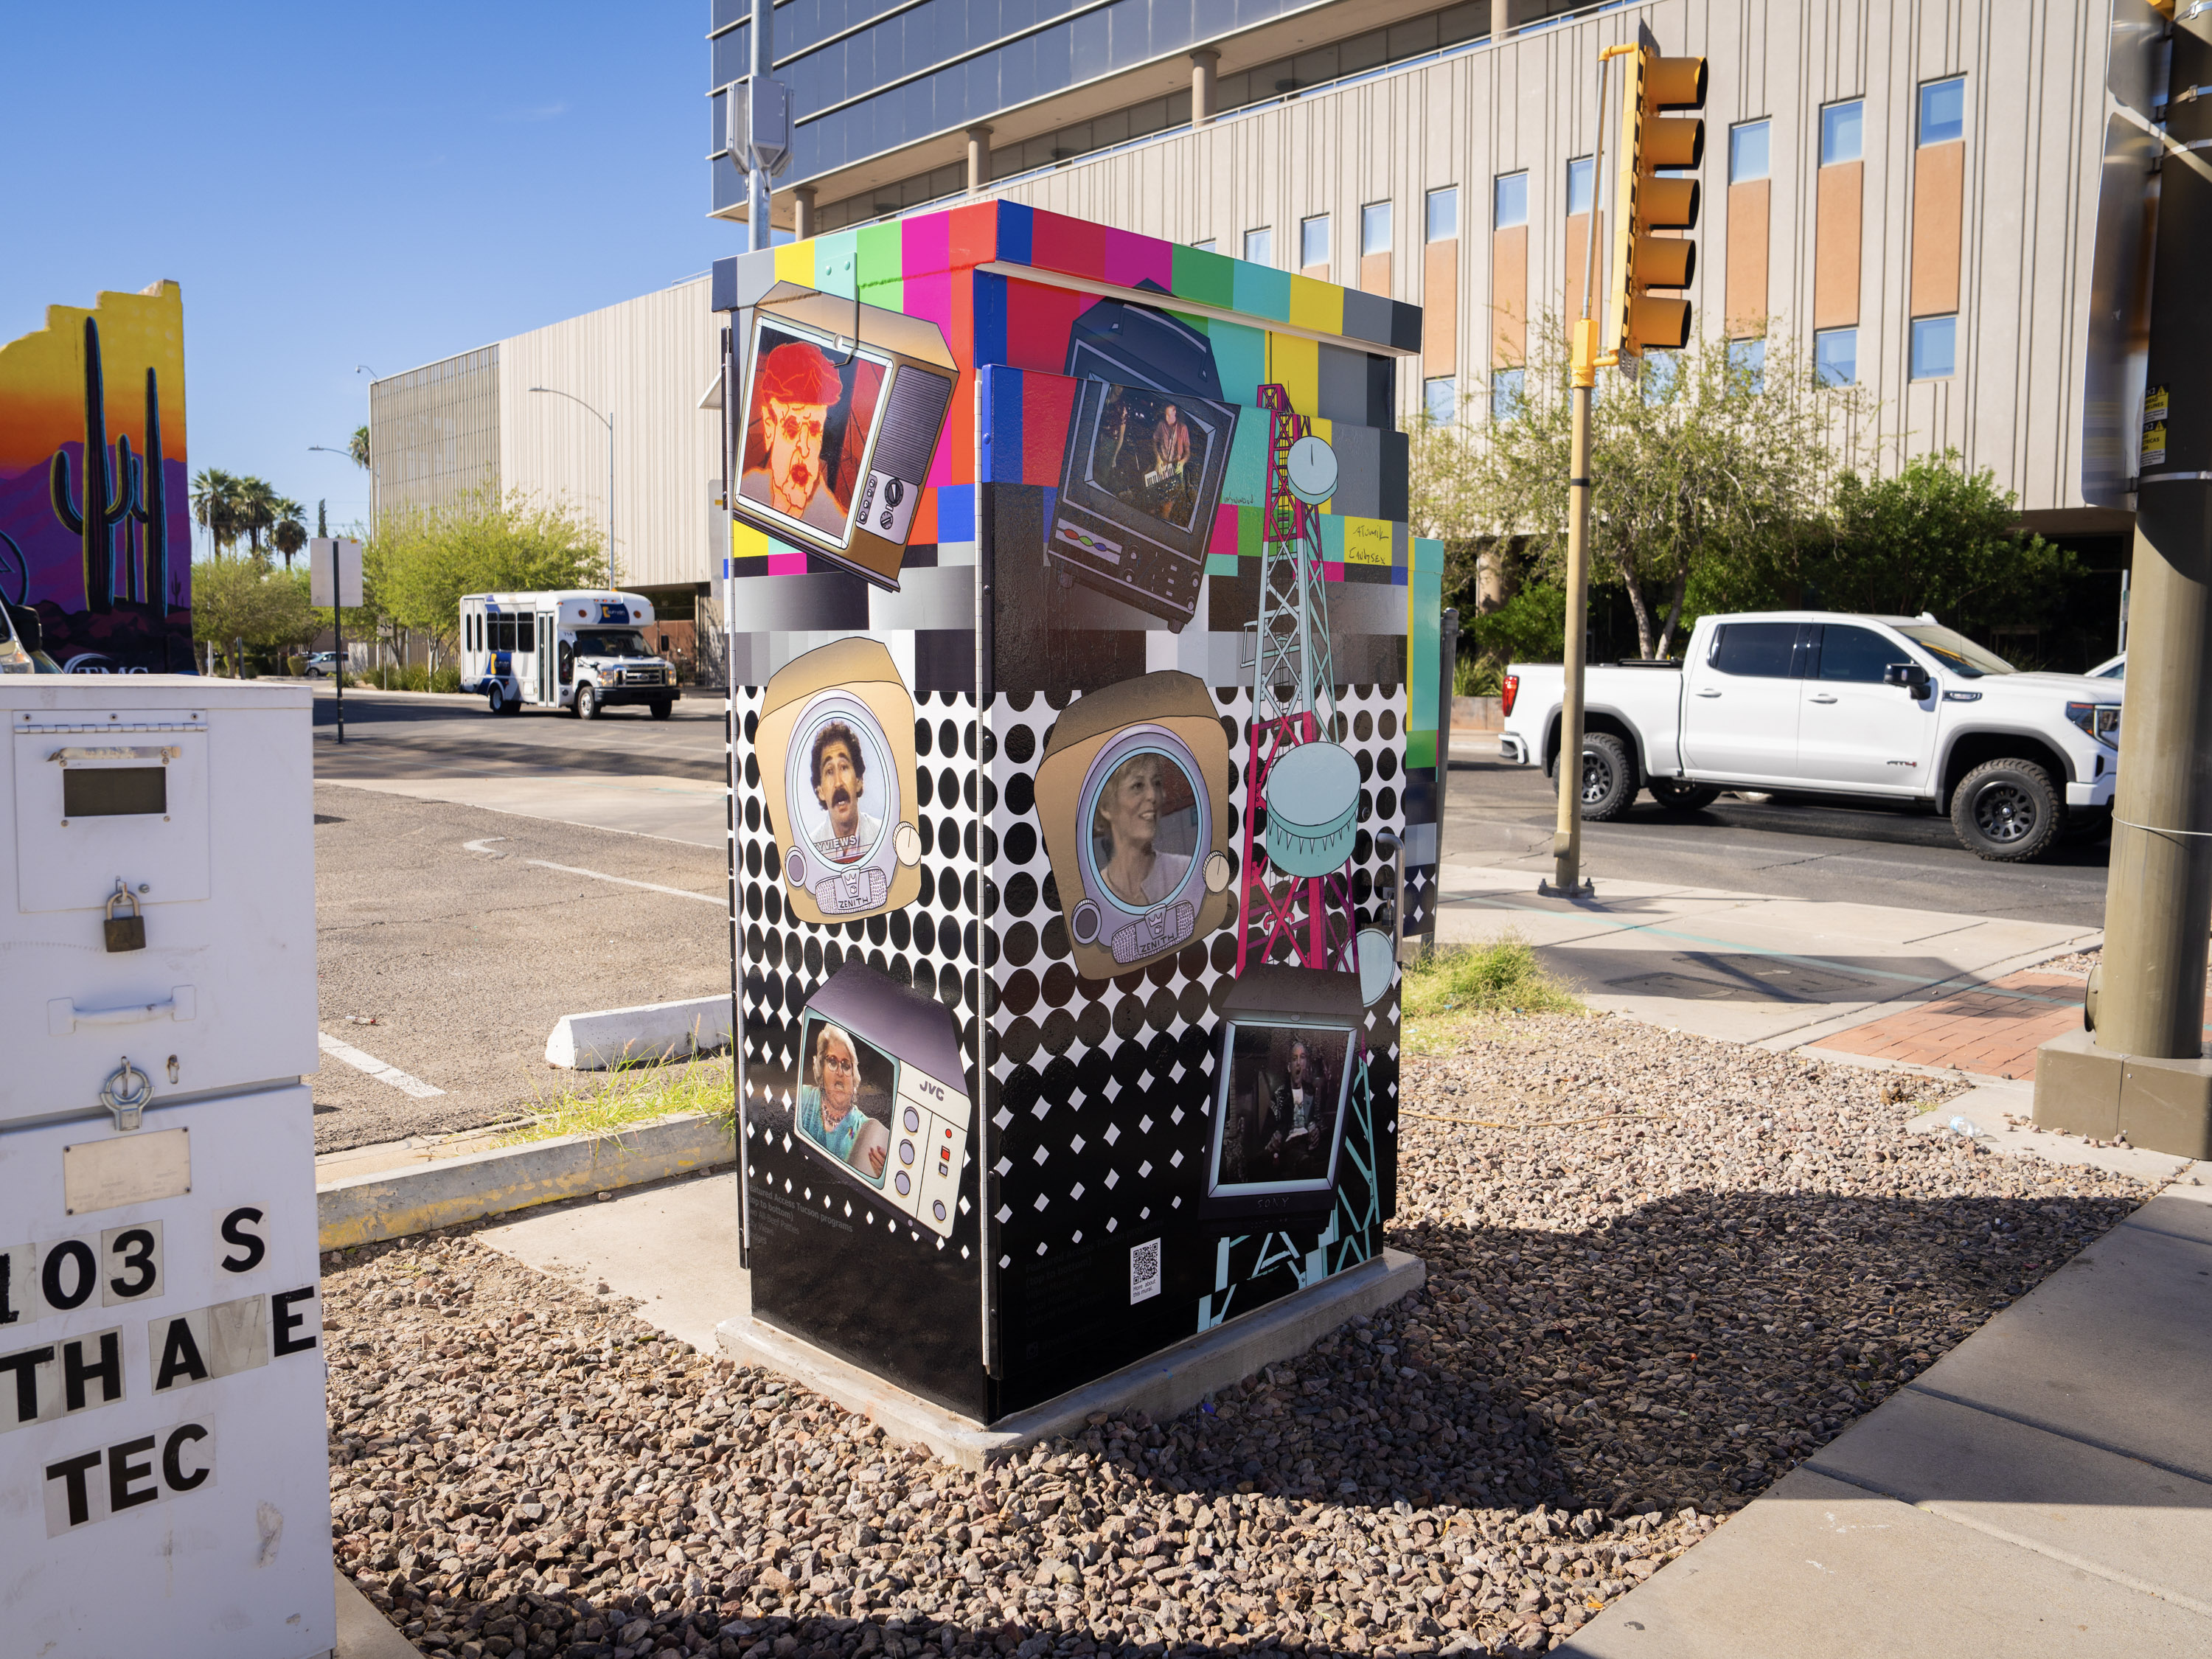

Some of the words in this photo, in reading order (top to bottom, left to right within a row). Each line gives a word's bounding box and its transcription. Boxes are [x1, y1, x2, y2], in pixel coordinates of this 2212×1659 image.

[814, 835, 858, 852] YVIEWS
[838, 896, 869, 909] ZENITH
[1139, 933, 1175, 954] ZENITH
[919, 1080, 945, 1102] JVC
[748, 1185, 773, 1200] eatured
[774, 1193, 796, 1209] Access
[796, 1202, 819, 1220] Tucson
[821, 1213, 854, 1233] programs
[749, 1194, 759, 1208] top
[760, 1199, 767, 1209] to
[768, 1203, 793, 1222] bottom)
[749, 1208, 757, 1217] wo
[1256, 1197, 1290, 1209] SONY
[220, 1207, 266, 1273] S
[1133, 1284, 1143, 1292] More
[1144, 1279, 1156, 1287] about
[1141, 1286, 1152, 1295] mural.
[46, 1424, 210, 1526] TEC
